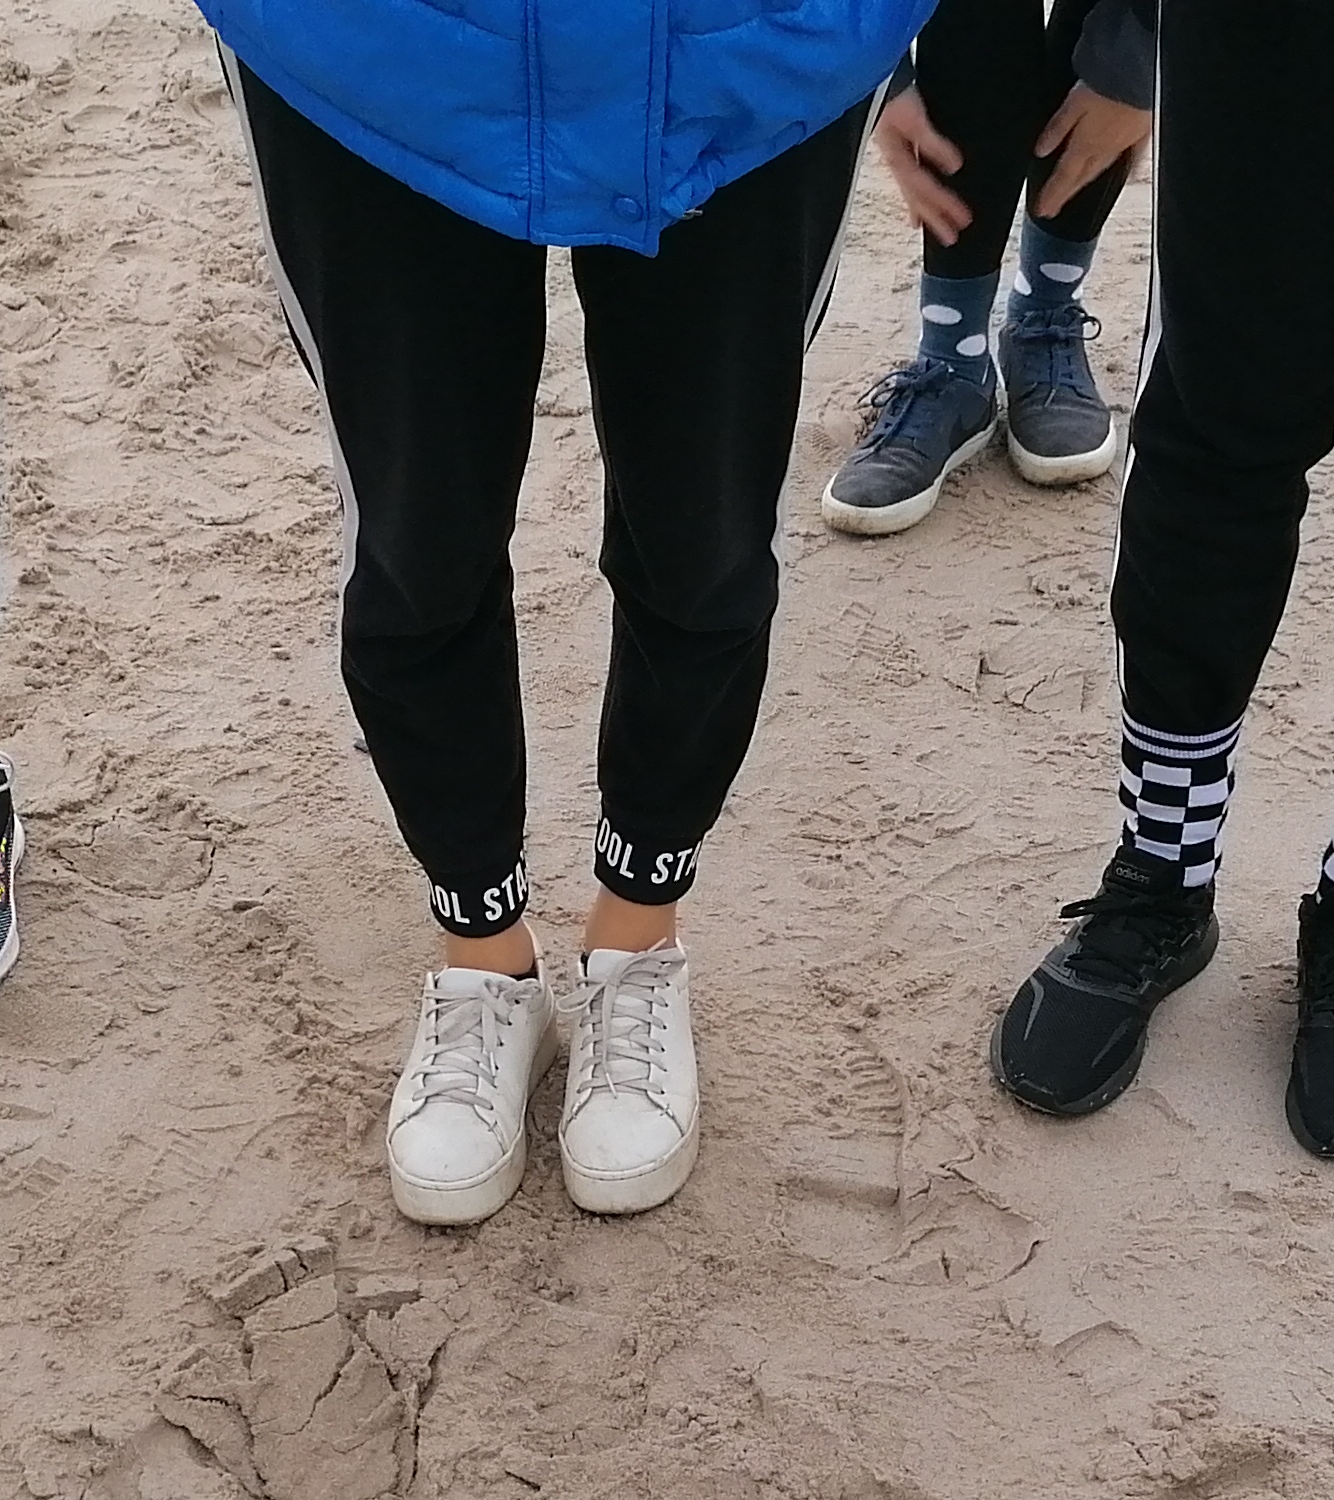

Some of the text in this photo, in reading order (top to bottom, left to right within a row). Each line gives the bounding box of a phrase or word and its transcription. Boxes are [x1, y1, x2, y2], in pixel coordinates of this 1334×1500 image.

[597, 802, 635, 879] OOL
[427, 851, 527, 924] OL STA
